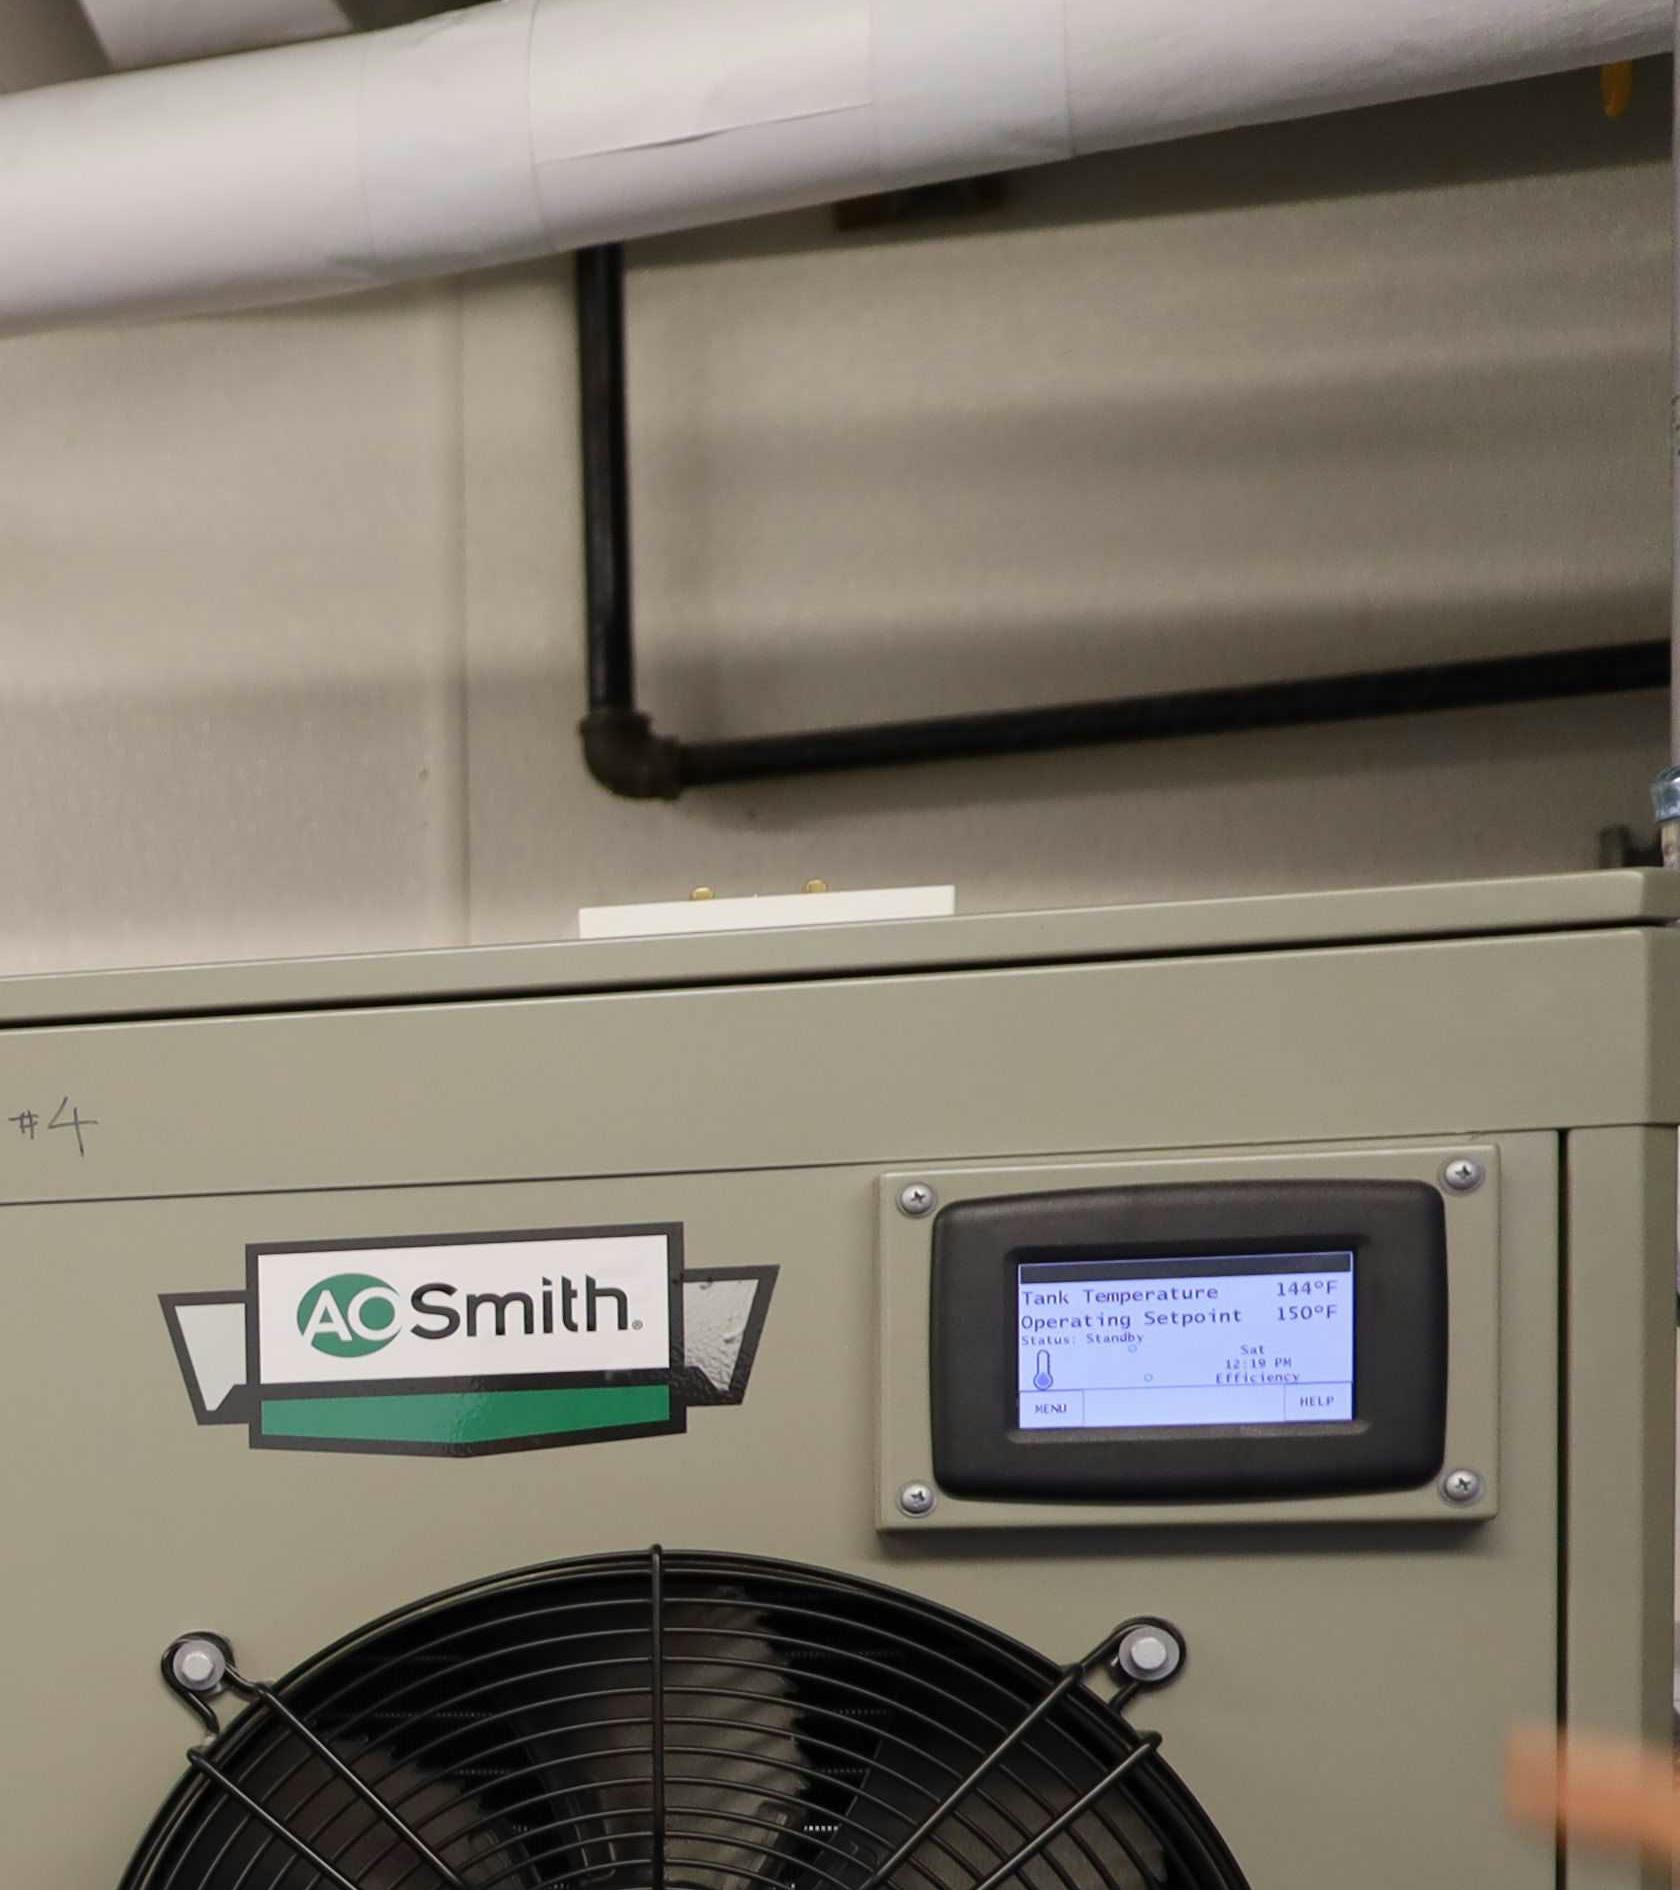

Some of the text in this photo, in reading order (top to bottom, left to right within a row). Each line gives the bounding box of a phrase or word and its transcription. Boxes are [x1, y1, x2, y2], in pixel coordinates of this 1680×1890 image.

[7, 1096, 100, 1158] #4
[1021, 1289, 1070, 1306] Tank
[1083, 1286, 1219, 1306] Temperature
[1020, 1313, 1131, 1331] Operating
[1143, 1308, 1243, 1327] Setpoint
[1021, 1332, 1144, 1346] Status: Standby
[1033, 1395, 1335, 1415] MENU HELP
